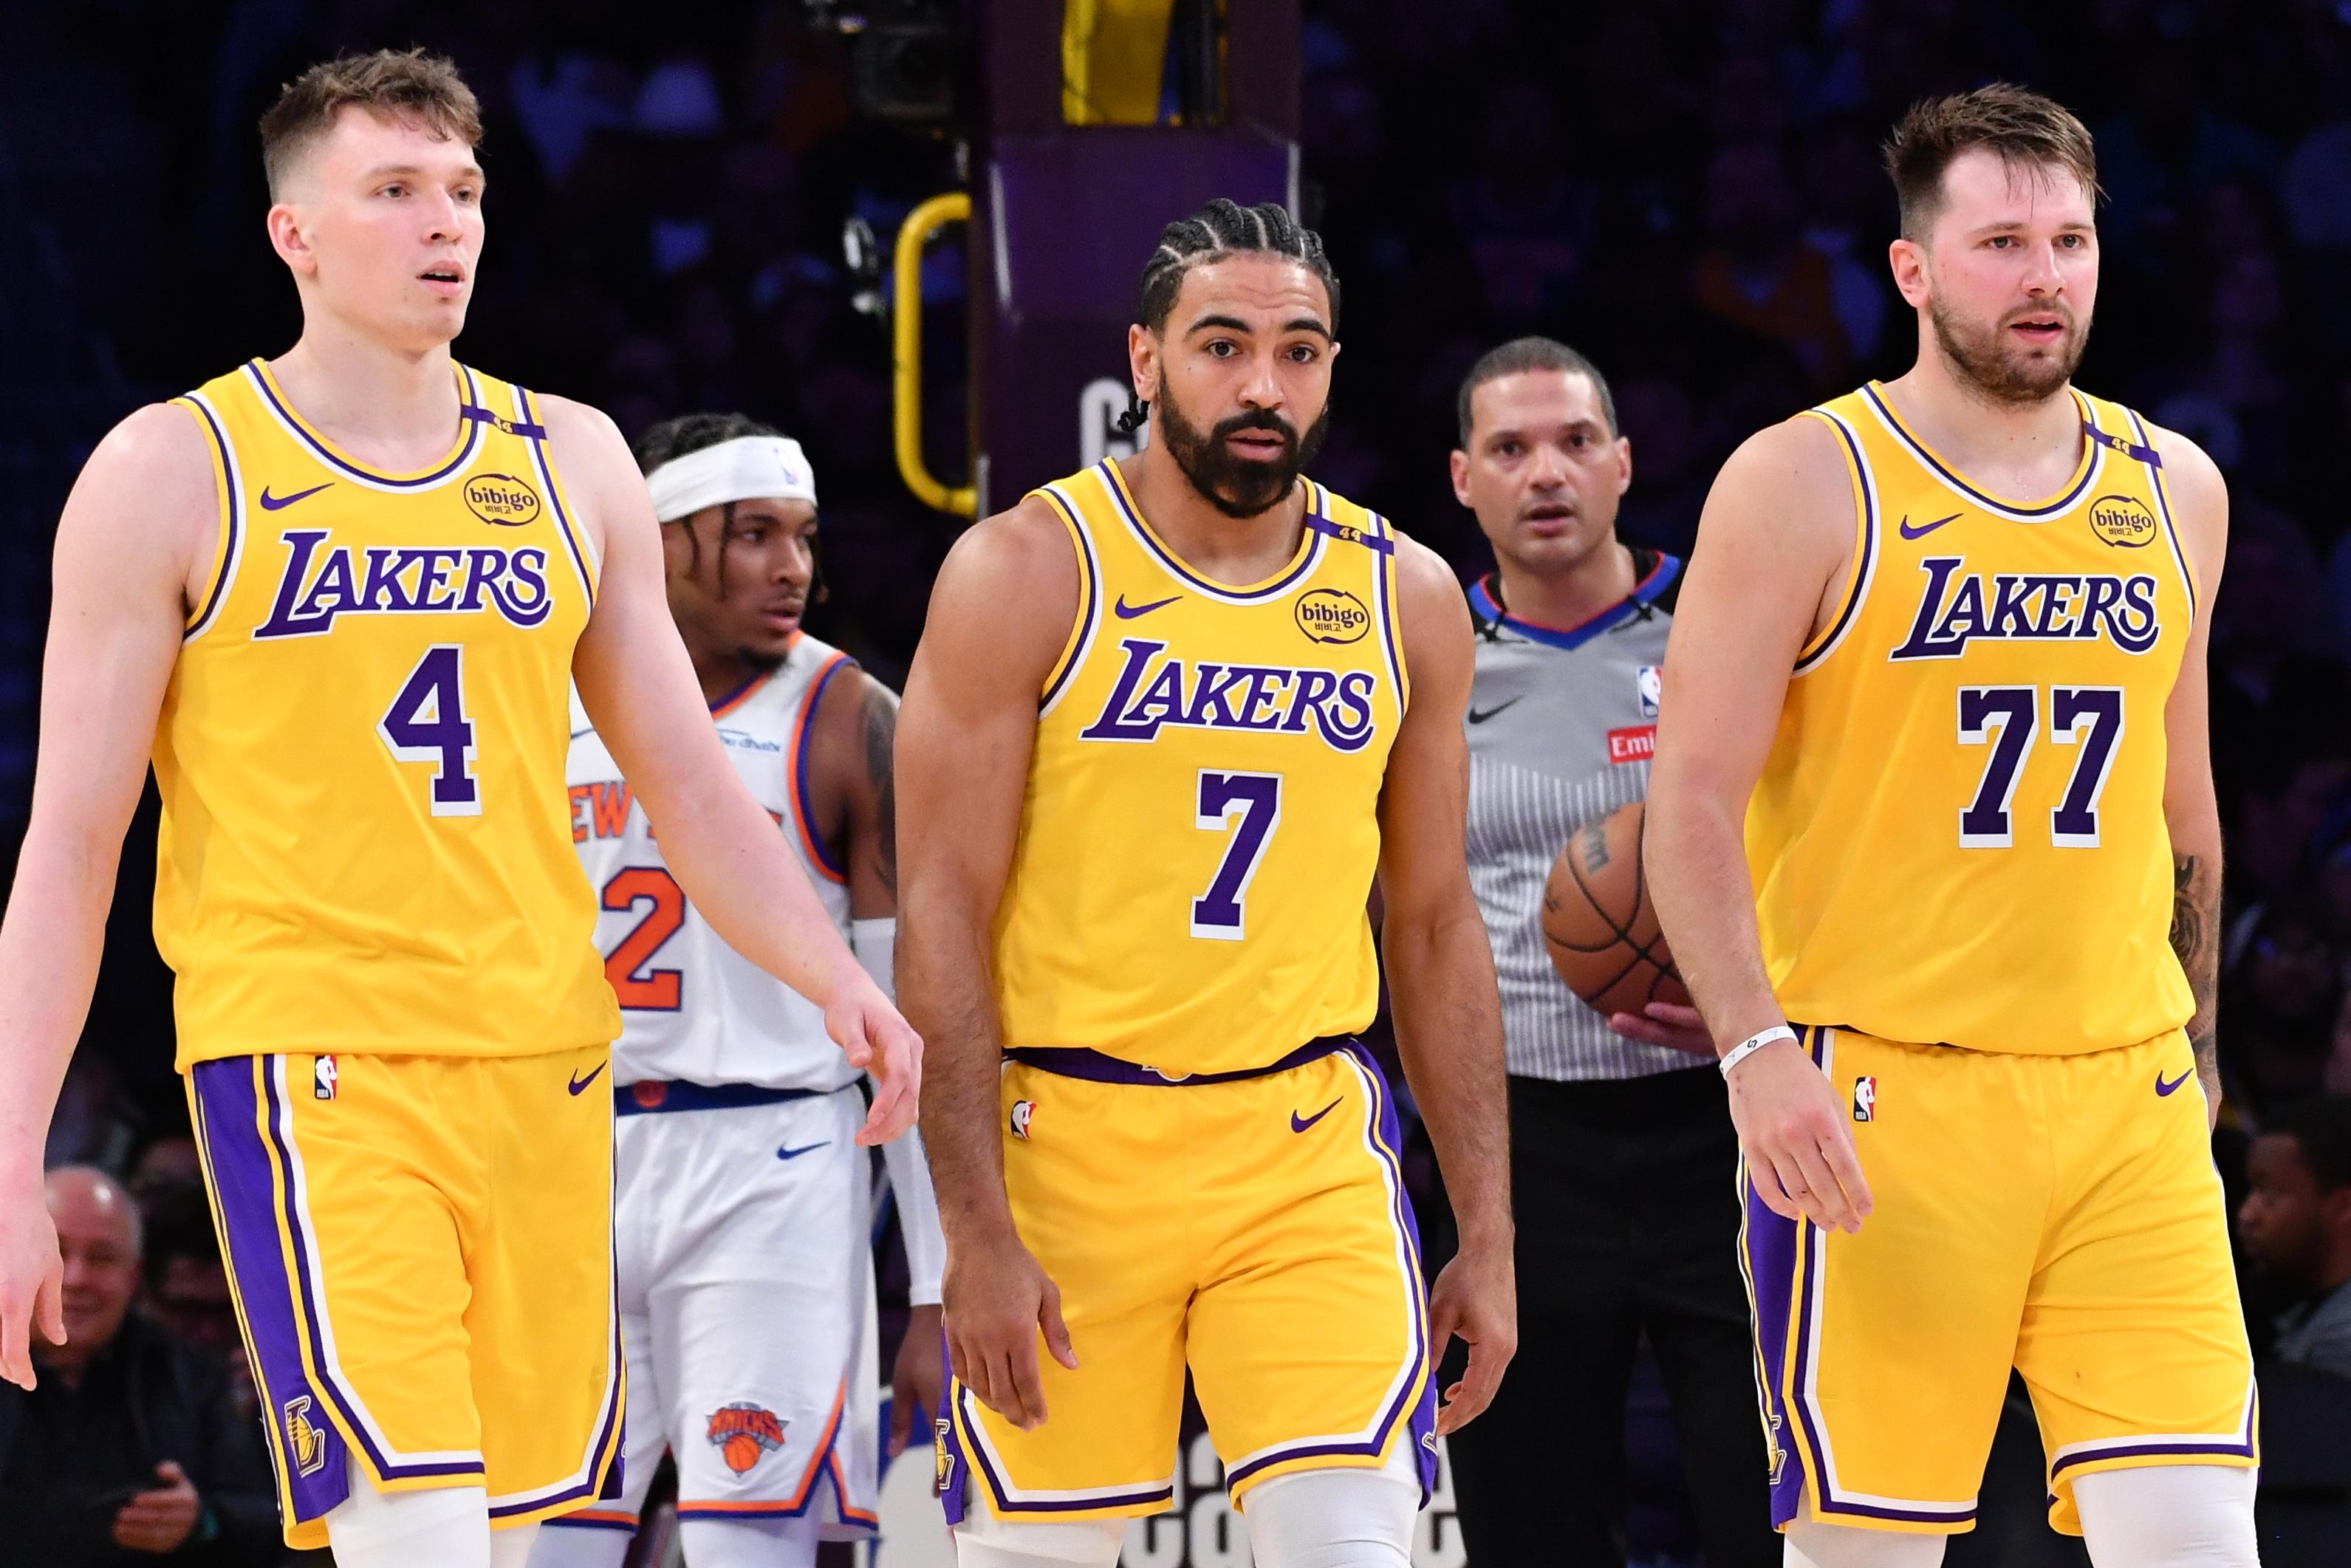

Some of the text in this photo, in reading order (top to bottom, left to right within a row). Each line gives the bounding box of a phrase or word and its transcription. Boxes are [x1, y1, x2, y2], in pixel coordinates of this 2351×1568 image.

[2111, 437, 2130, 455] 44
[469, 487, 535, 511] bibigo
[485, 504, 512, 515] 비비고
[2095, 509, 2152, 533] bibigo
[1338, 527, 1361, 542] 44
[2108, 527, 2132, 536] 비비고
[251, 528, 555, 642] LAKERS
[1301, 602, 1366, 629] bibigo
[1315, 623, 1342, 632] 비비고
[1887, 555, 2163, 663] LAKERS
[1077, 636, 1377, 755] LAKERS
[374, 643, 482, 817] 4
[1957, 685, 2126, 849] 77
[567, 781, 634, 843] EW
[1190, 768, 1283, 941] 7
[600, 866, 686, 1012] 2
